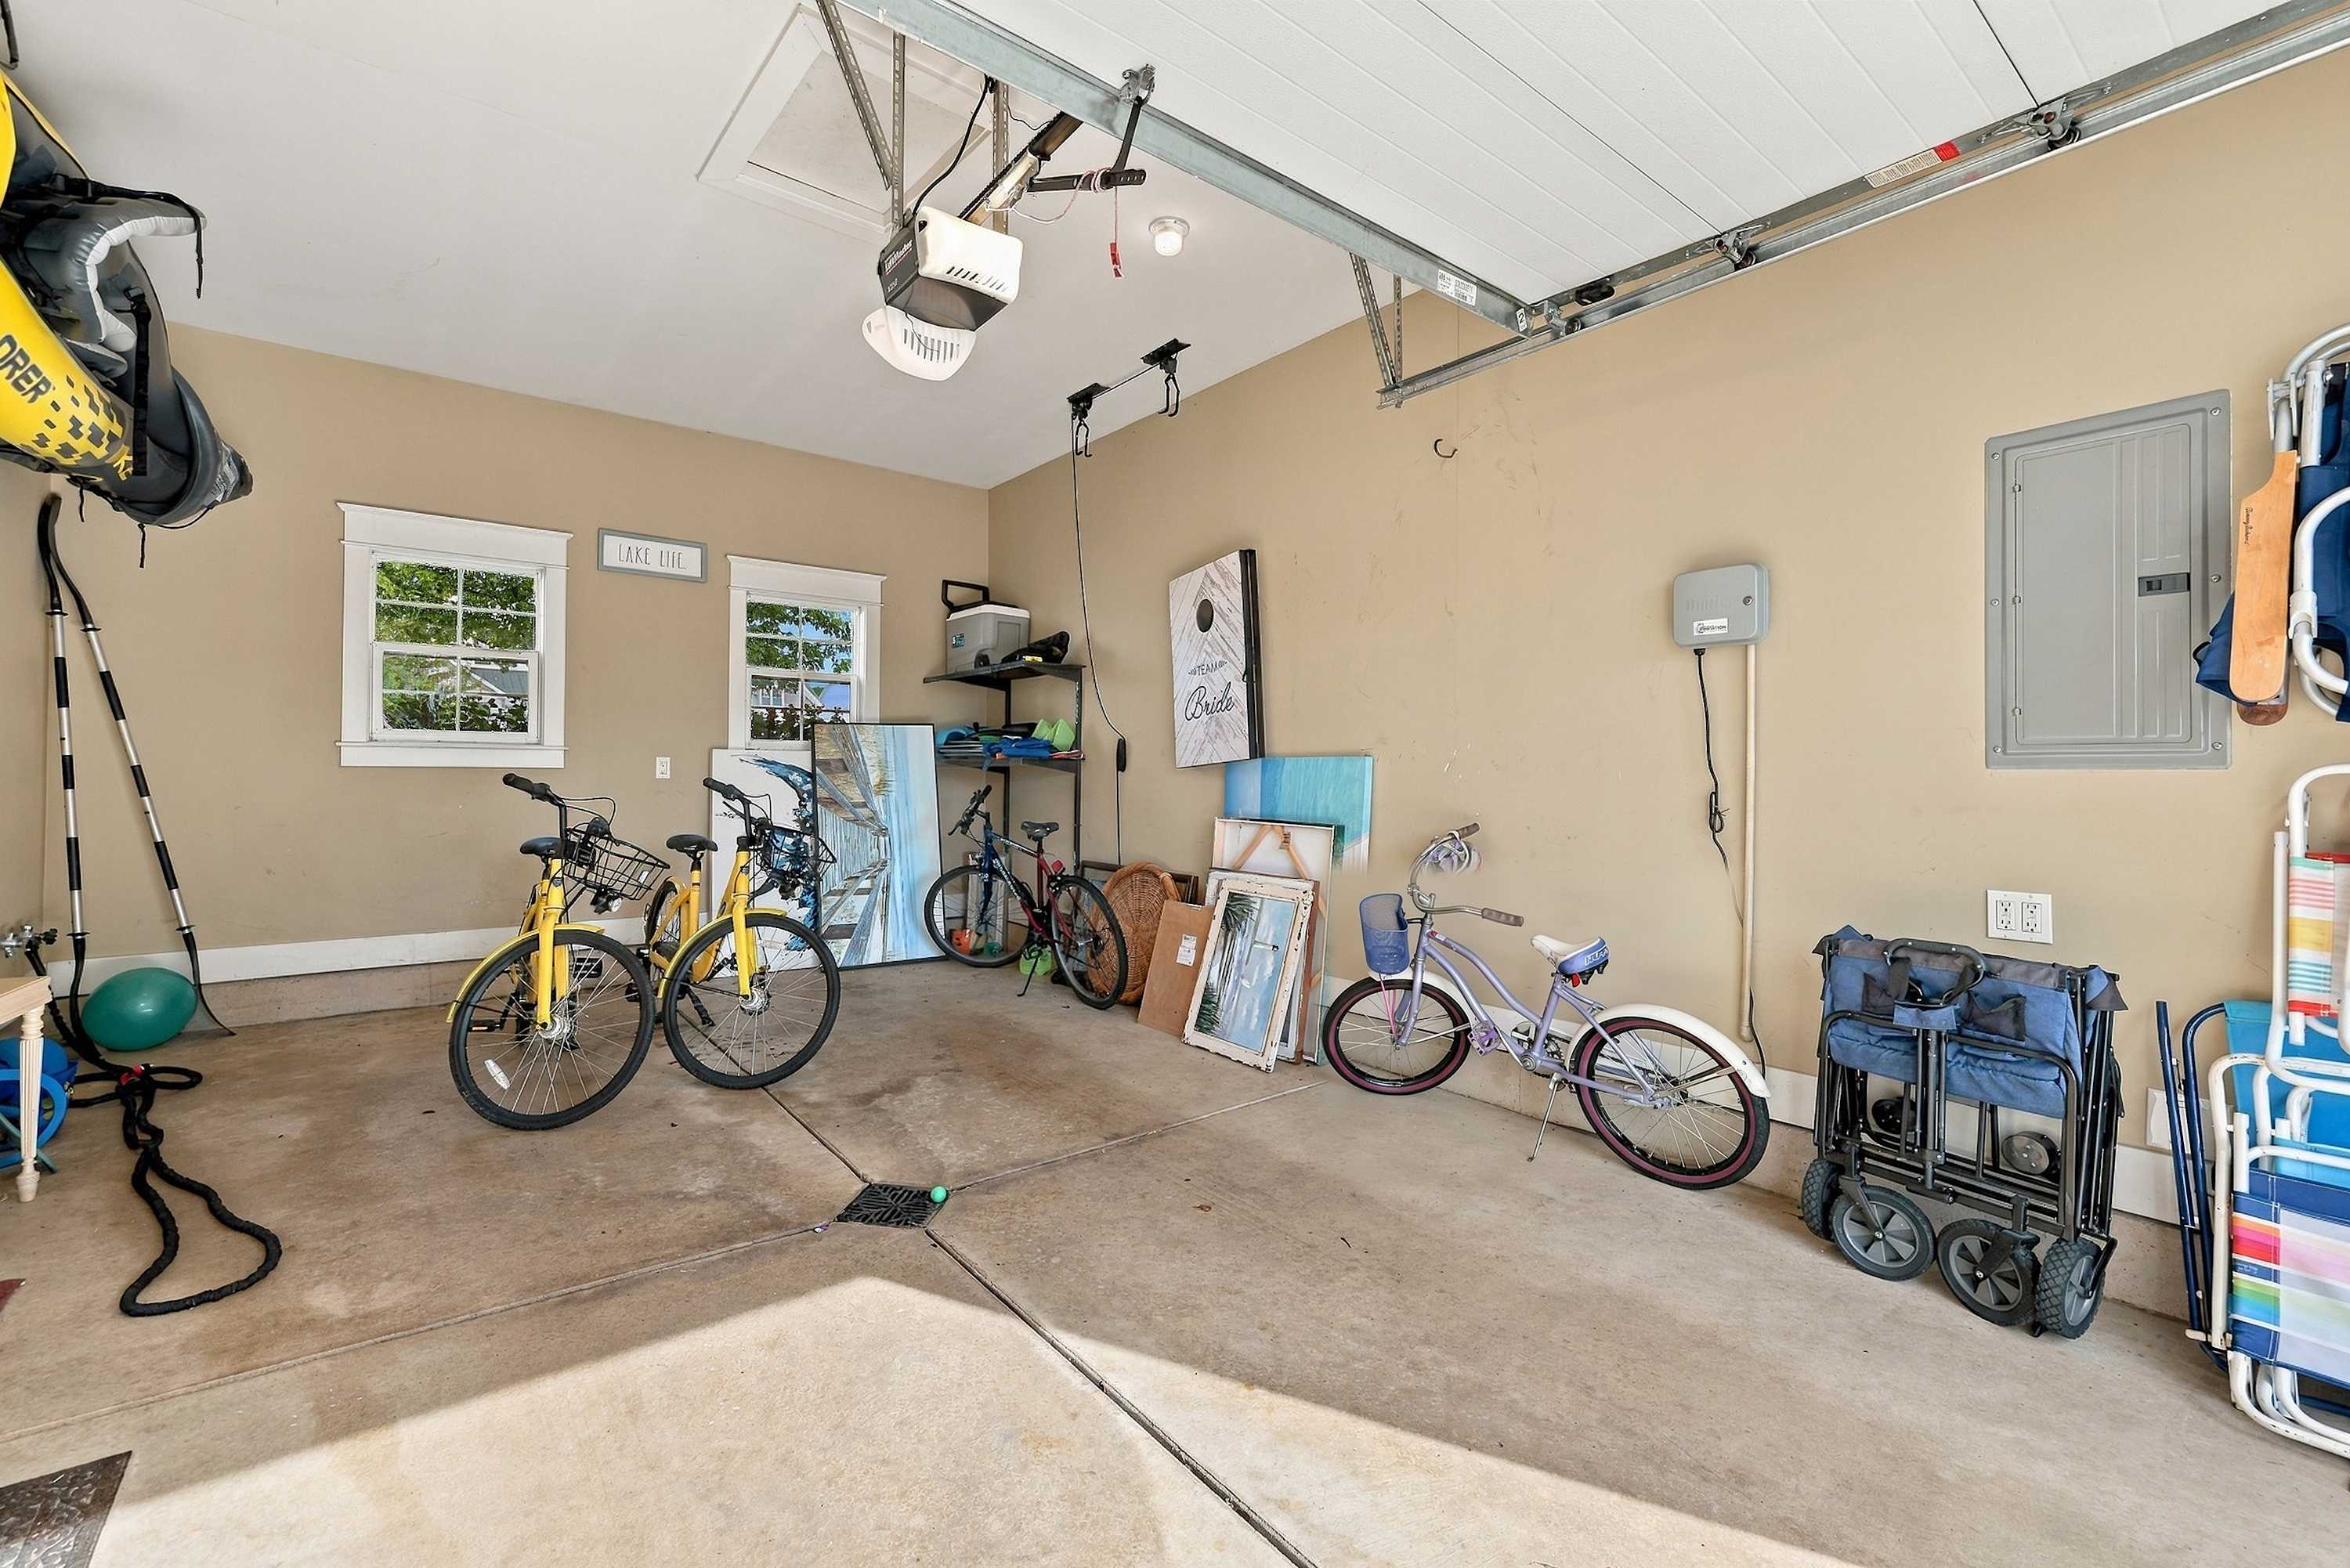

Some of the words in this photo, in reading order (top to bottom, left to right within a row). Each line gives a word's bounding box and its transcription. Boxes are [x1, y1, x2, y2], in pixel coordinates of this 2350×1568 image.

[1518, 313, 1525, 324] 2
[0, 334, 52, 404] ORER
[618, 544, 651, 565] LAKE
[660, 550, 684, 569] LIFE
[1197, 663, 1218, 677] TEAM
[1184, 681, 1235, 722] Bride
